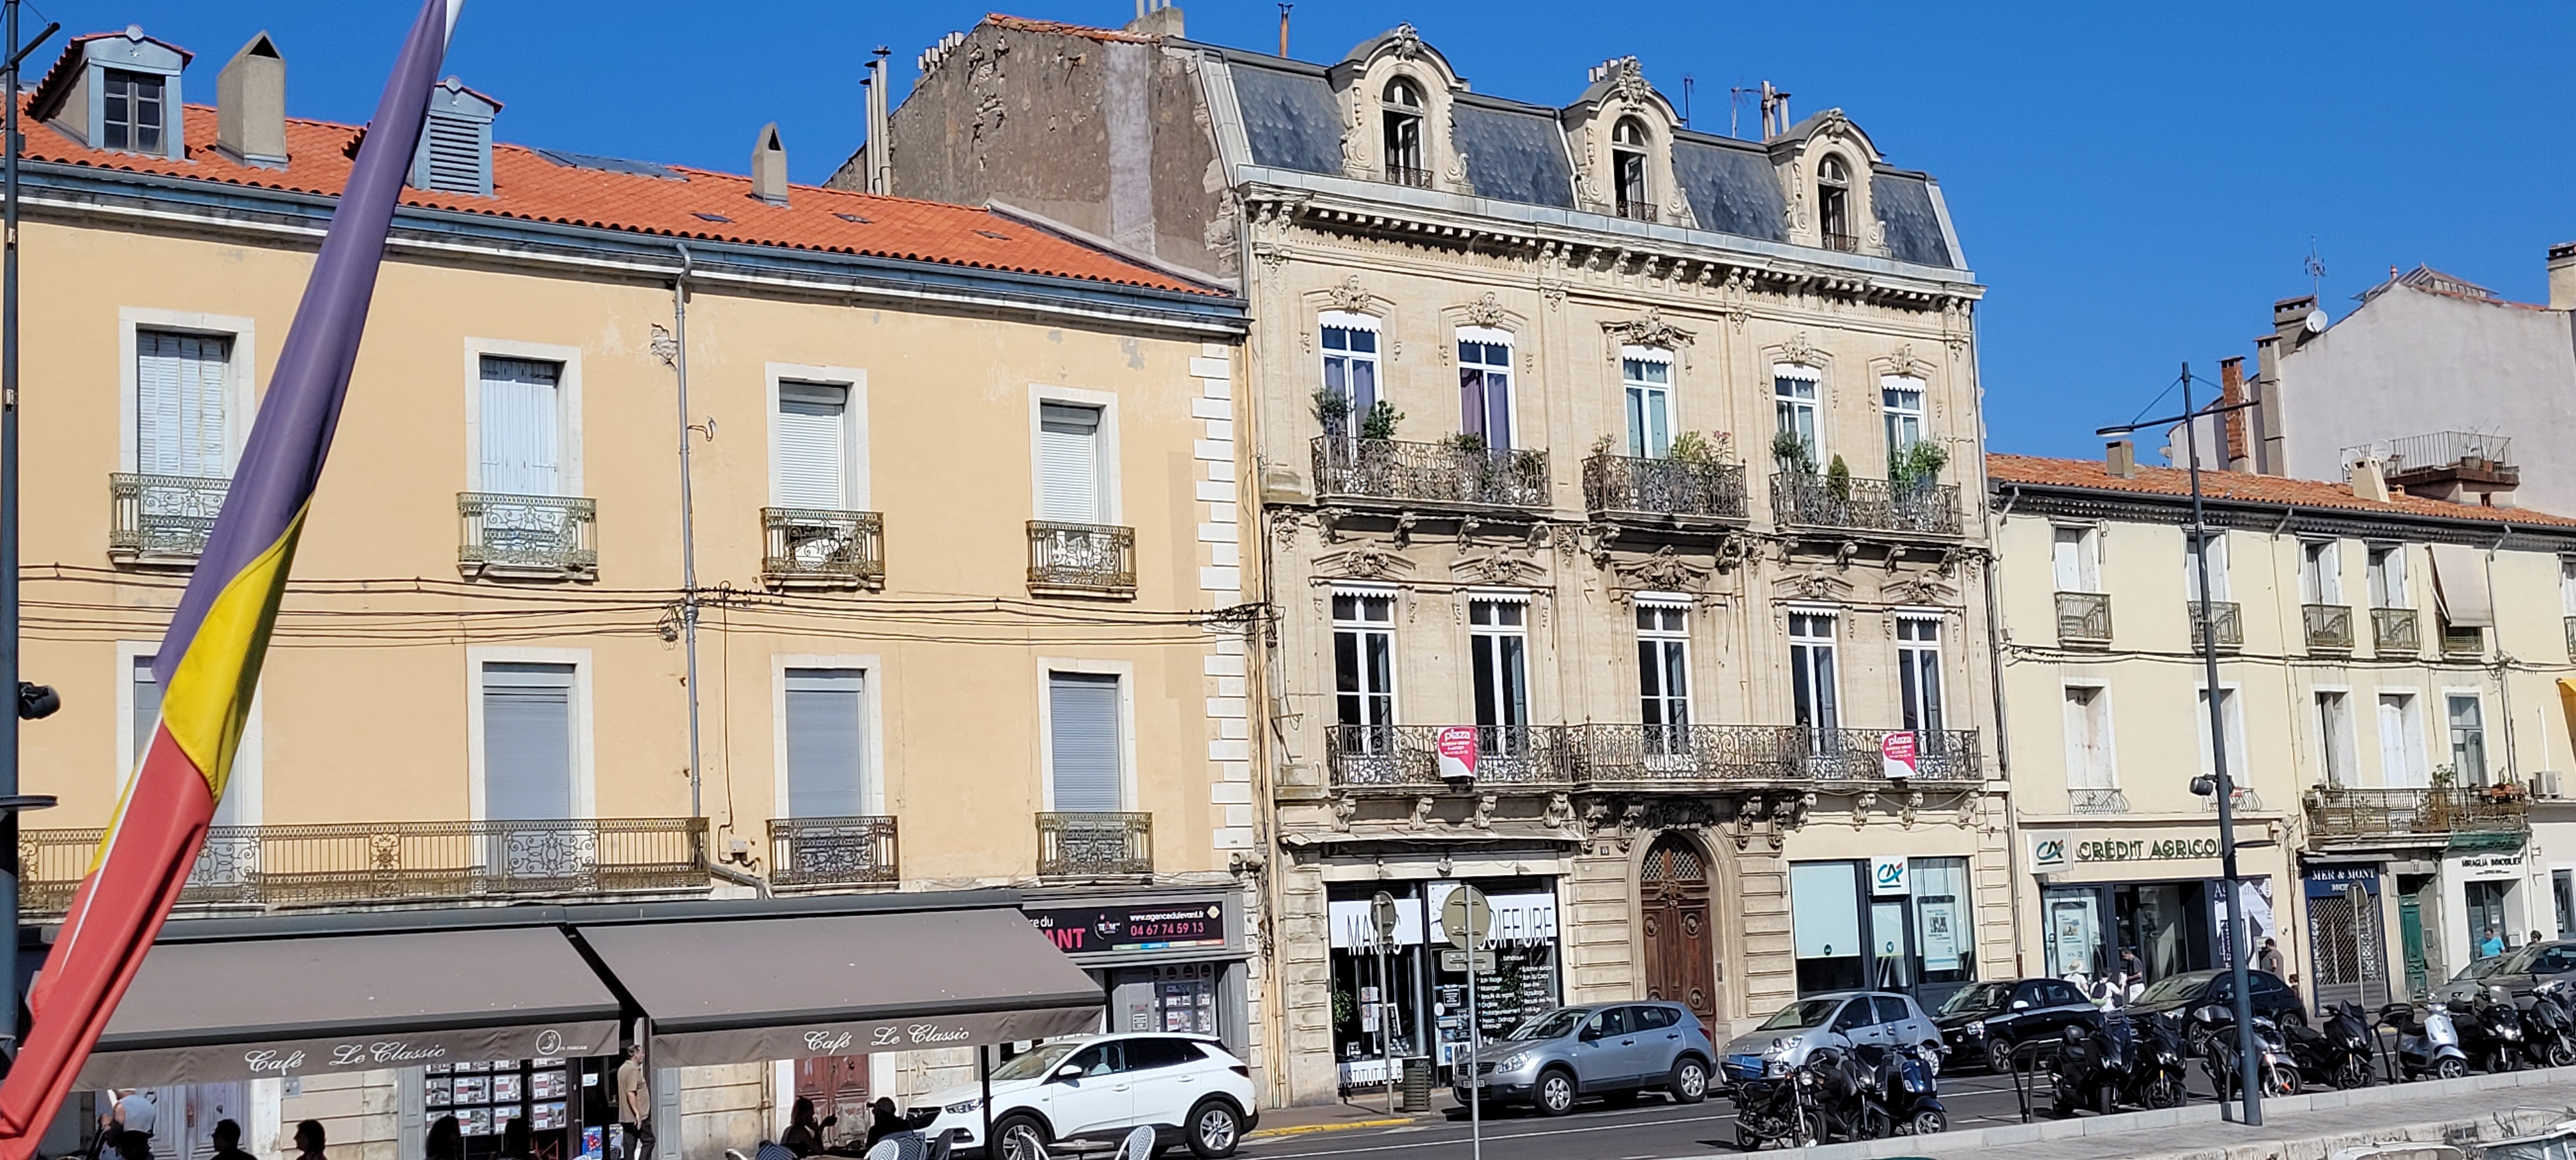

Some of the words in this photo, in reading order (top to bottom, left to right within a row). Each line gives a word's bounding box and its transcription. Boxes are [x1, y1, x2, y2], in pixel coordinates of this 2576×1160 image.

[2076, 837, 2144, 859] CRÉDIT
[2150, 838, 2223, 857] AGRICOL
[2312, 869, 2335, 880] MER
[2338, 871, 2345, 879] &
[2347, 867, 2375, 879] MONT
[1040, 915, 1054, 927] du
[1130, 924, 1144, 936] 04
[1146, 924, 1158, 935] 67
[1162, 923, 1174, 935] 74
[1177, 922, 1188, 934] 59
[1192, 922, 1204, 933] 13
[1477, 907, 1555, 950] OIFFURE
[1045, 928, 1086, 949] ANT
[804, 1031, 852, 1055] Café
[871, 1026, 900, 1046] Le
[908, 1024, 969, 1044] Classic
[245, 1049, 305, 1076] Café
[328, 1045, 365, 1065] Le
[370, 1042, 445, 1064] Classic
